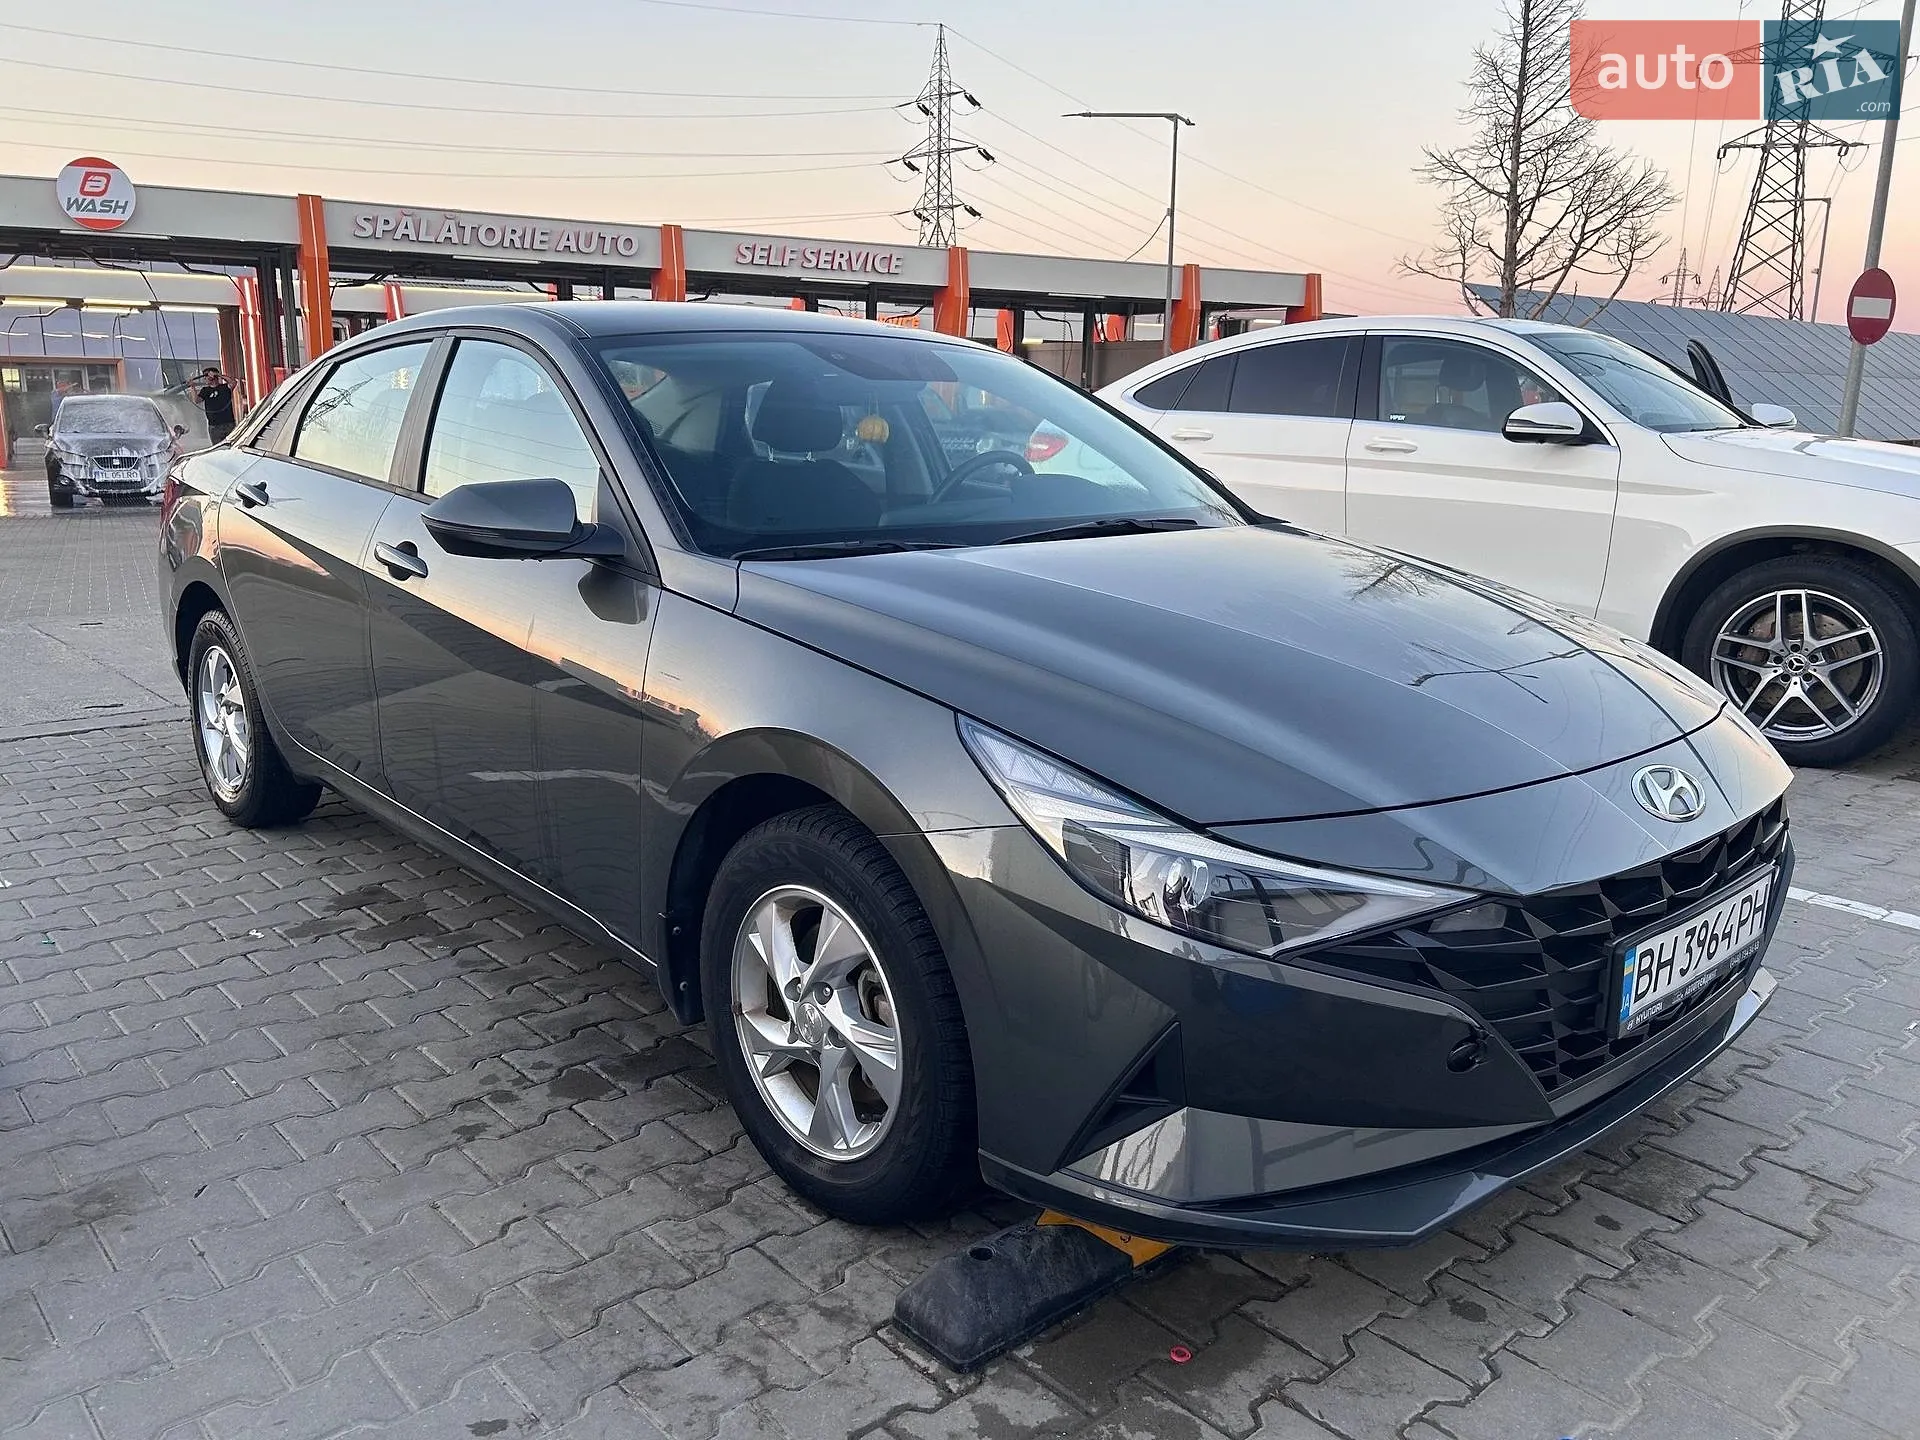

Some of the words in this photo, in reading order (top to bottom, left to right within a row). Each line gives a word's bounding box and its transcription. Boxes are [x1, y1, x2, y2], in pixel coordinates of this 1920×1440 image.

[66, 197, 129, 214] WASH
[353, 209, 550, 251] SPĂLĂTORIE
[555, 230, 639, 257] AUTO
[736, 243, 798, 267] SELF
[800, 247, 904, 274] SERVICE
[1633, 936, 1679, 1004] BH
[1679, 903, 1736, 977] 3964
[1735, 884, 1769, 945] PH
